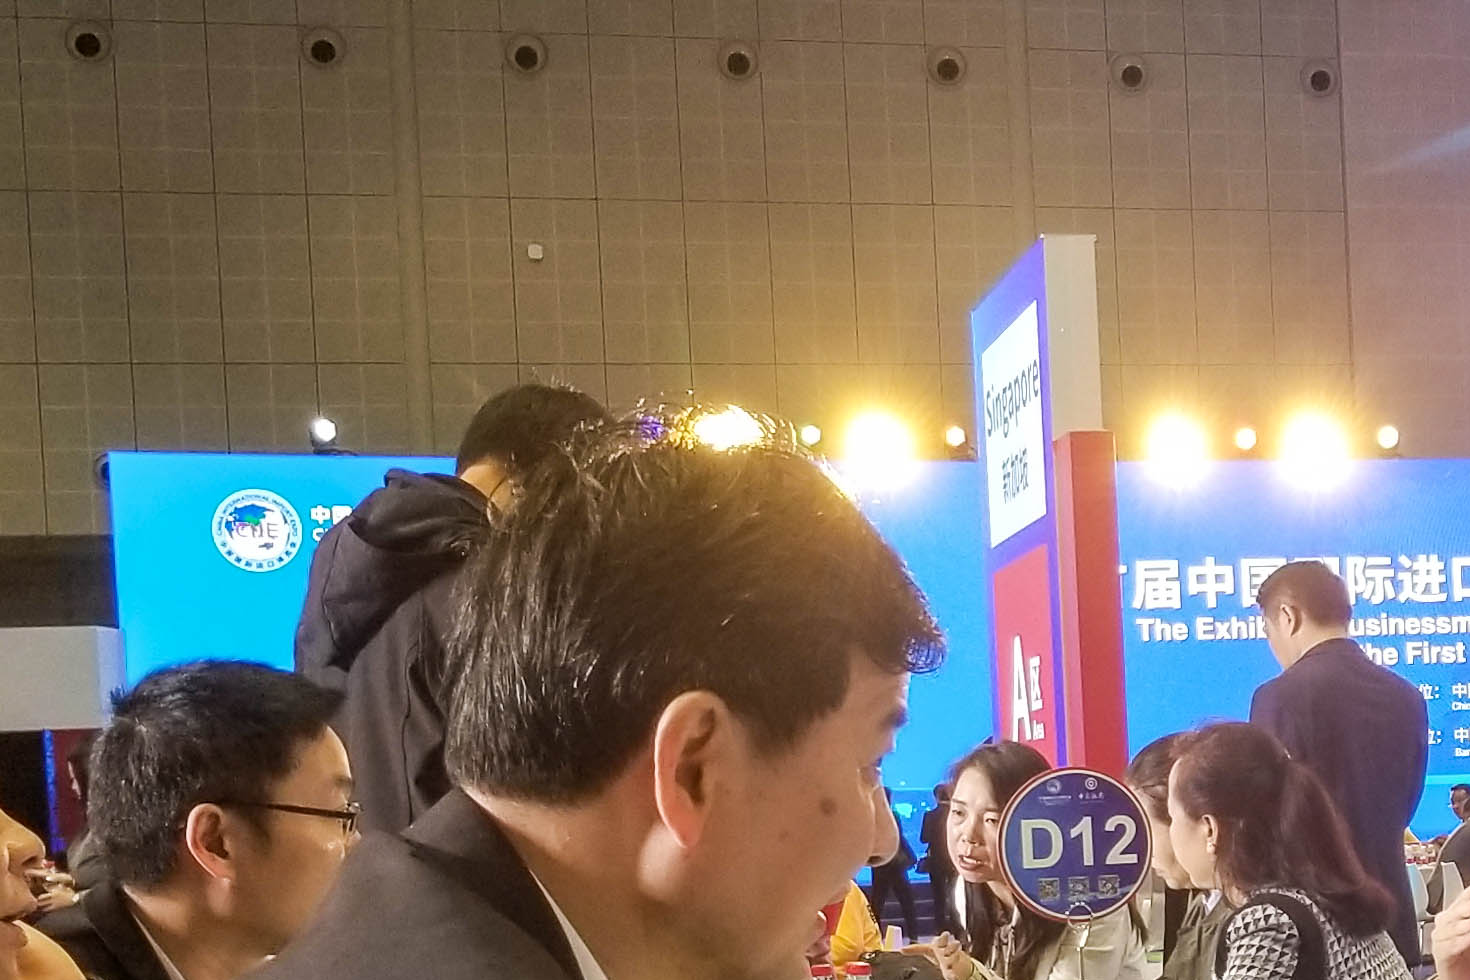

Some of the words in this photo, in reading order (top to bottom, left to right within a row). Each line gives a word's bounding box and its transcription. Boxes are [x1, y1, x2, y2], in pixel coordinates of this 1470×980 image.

[986, 359, 1039, 438] Singapore
[1136, 617, 1190, 642] The
[1195, 616, 1268, 641] Exhib
[1360, 642, 1399, 667] he
[1405, 640, 1468, 666] First
[1020, 814, 1138, 869] D12
